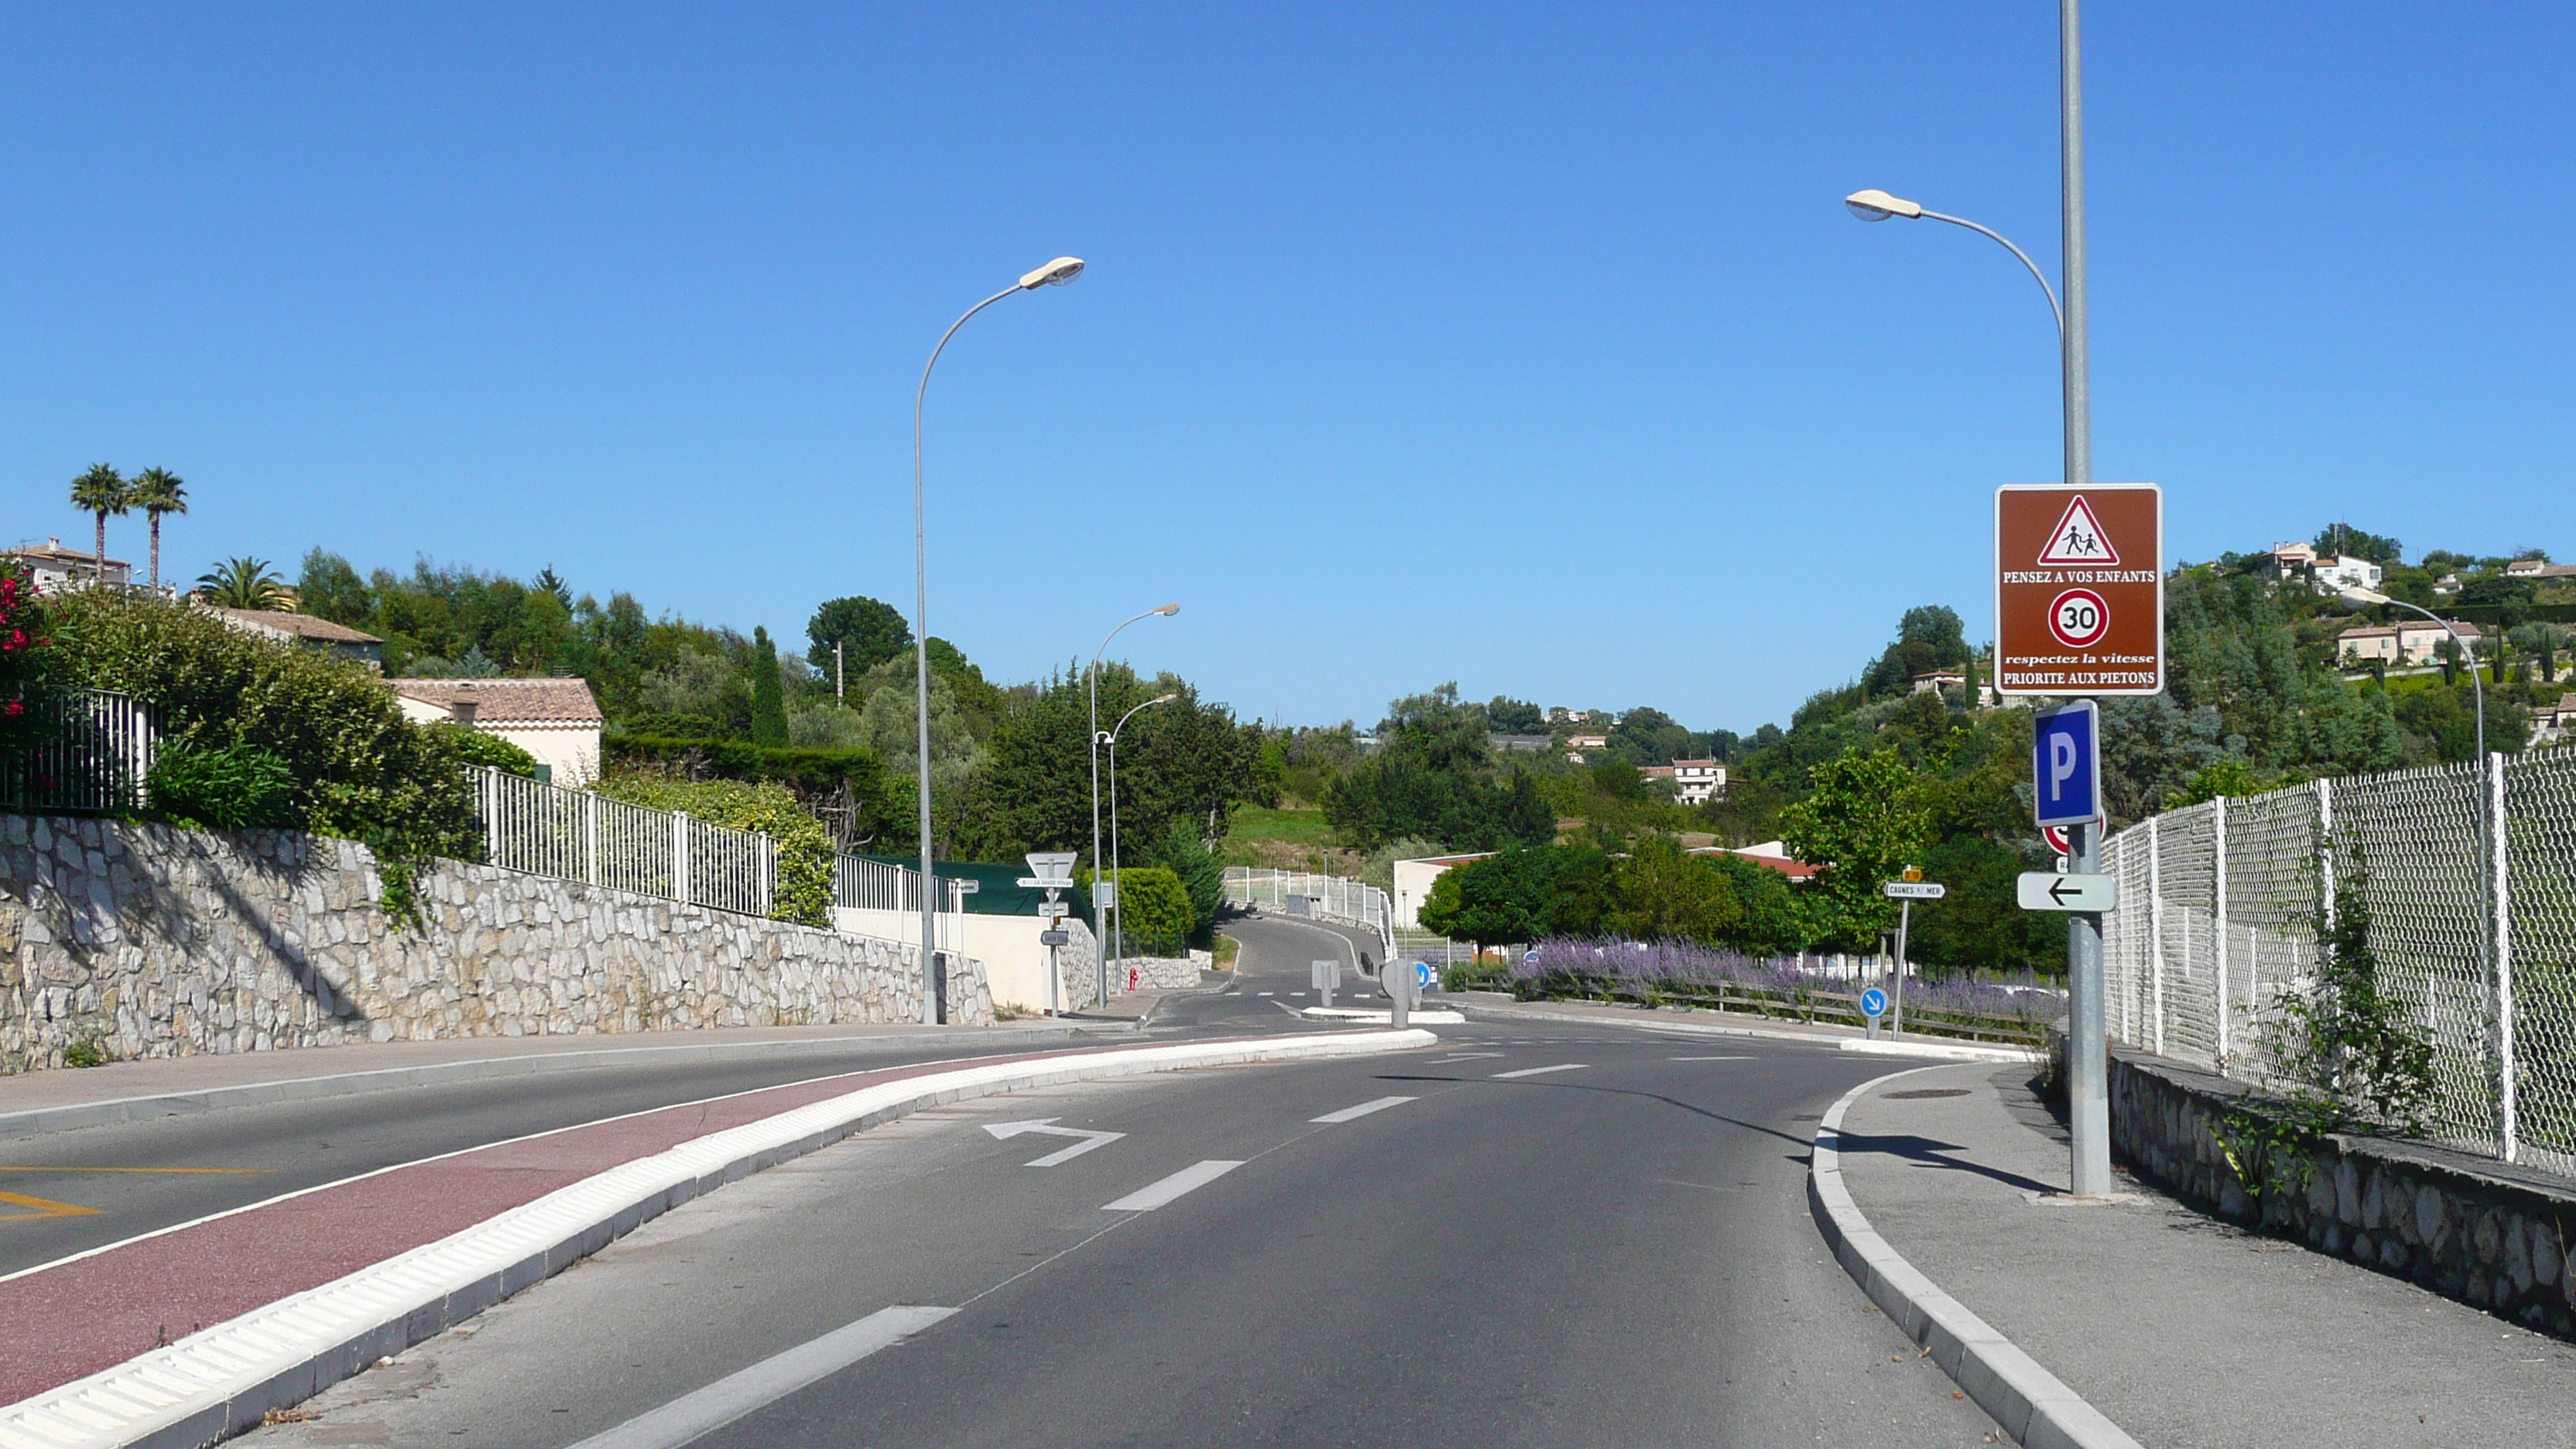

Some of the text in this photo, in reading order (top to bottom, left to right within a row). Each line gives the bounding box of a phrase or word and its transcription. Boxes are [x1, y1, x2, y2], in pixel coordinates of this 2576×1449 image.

[2003, 570, 2155, 583] PENSEZ A VOS ENFANTS
[2062, 607, 2096, 629] 30
[2005, 653, 2155, 667] respectez la vitesse
[2004, 672, 2155, 684] PRIORITE AUX PIETONS
[2050, 731, 2077, 801] P
